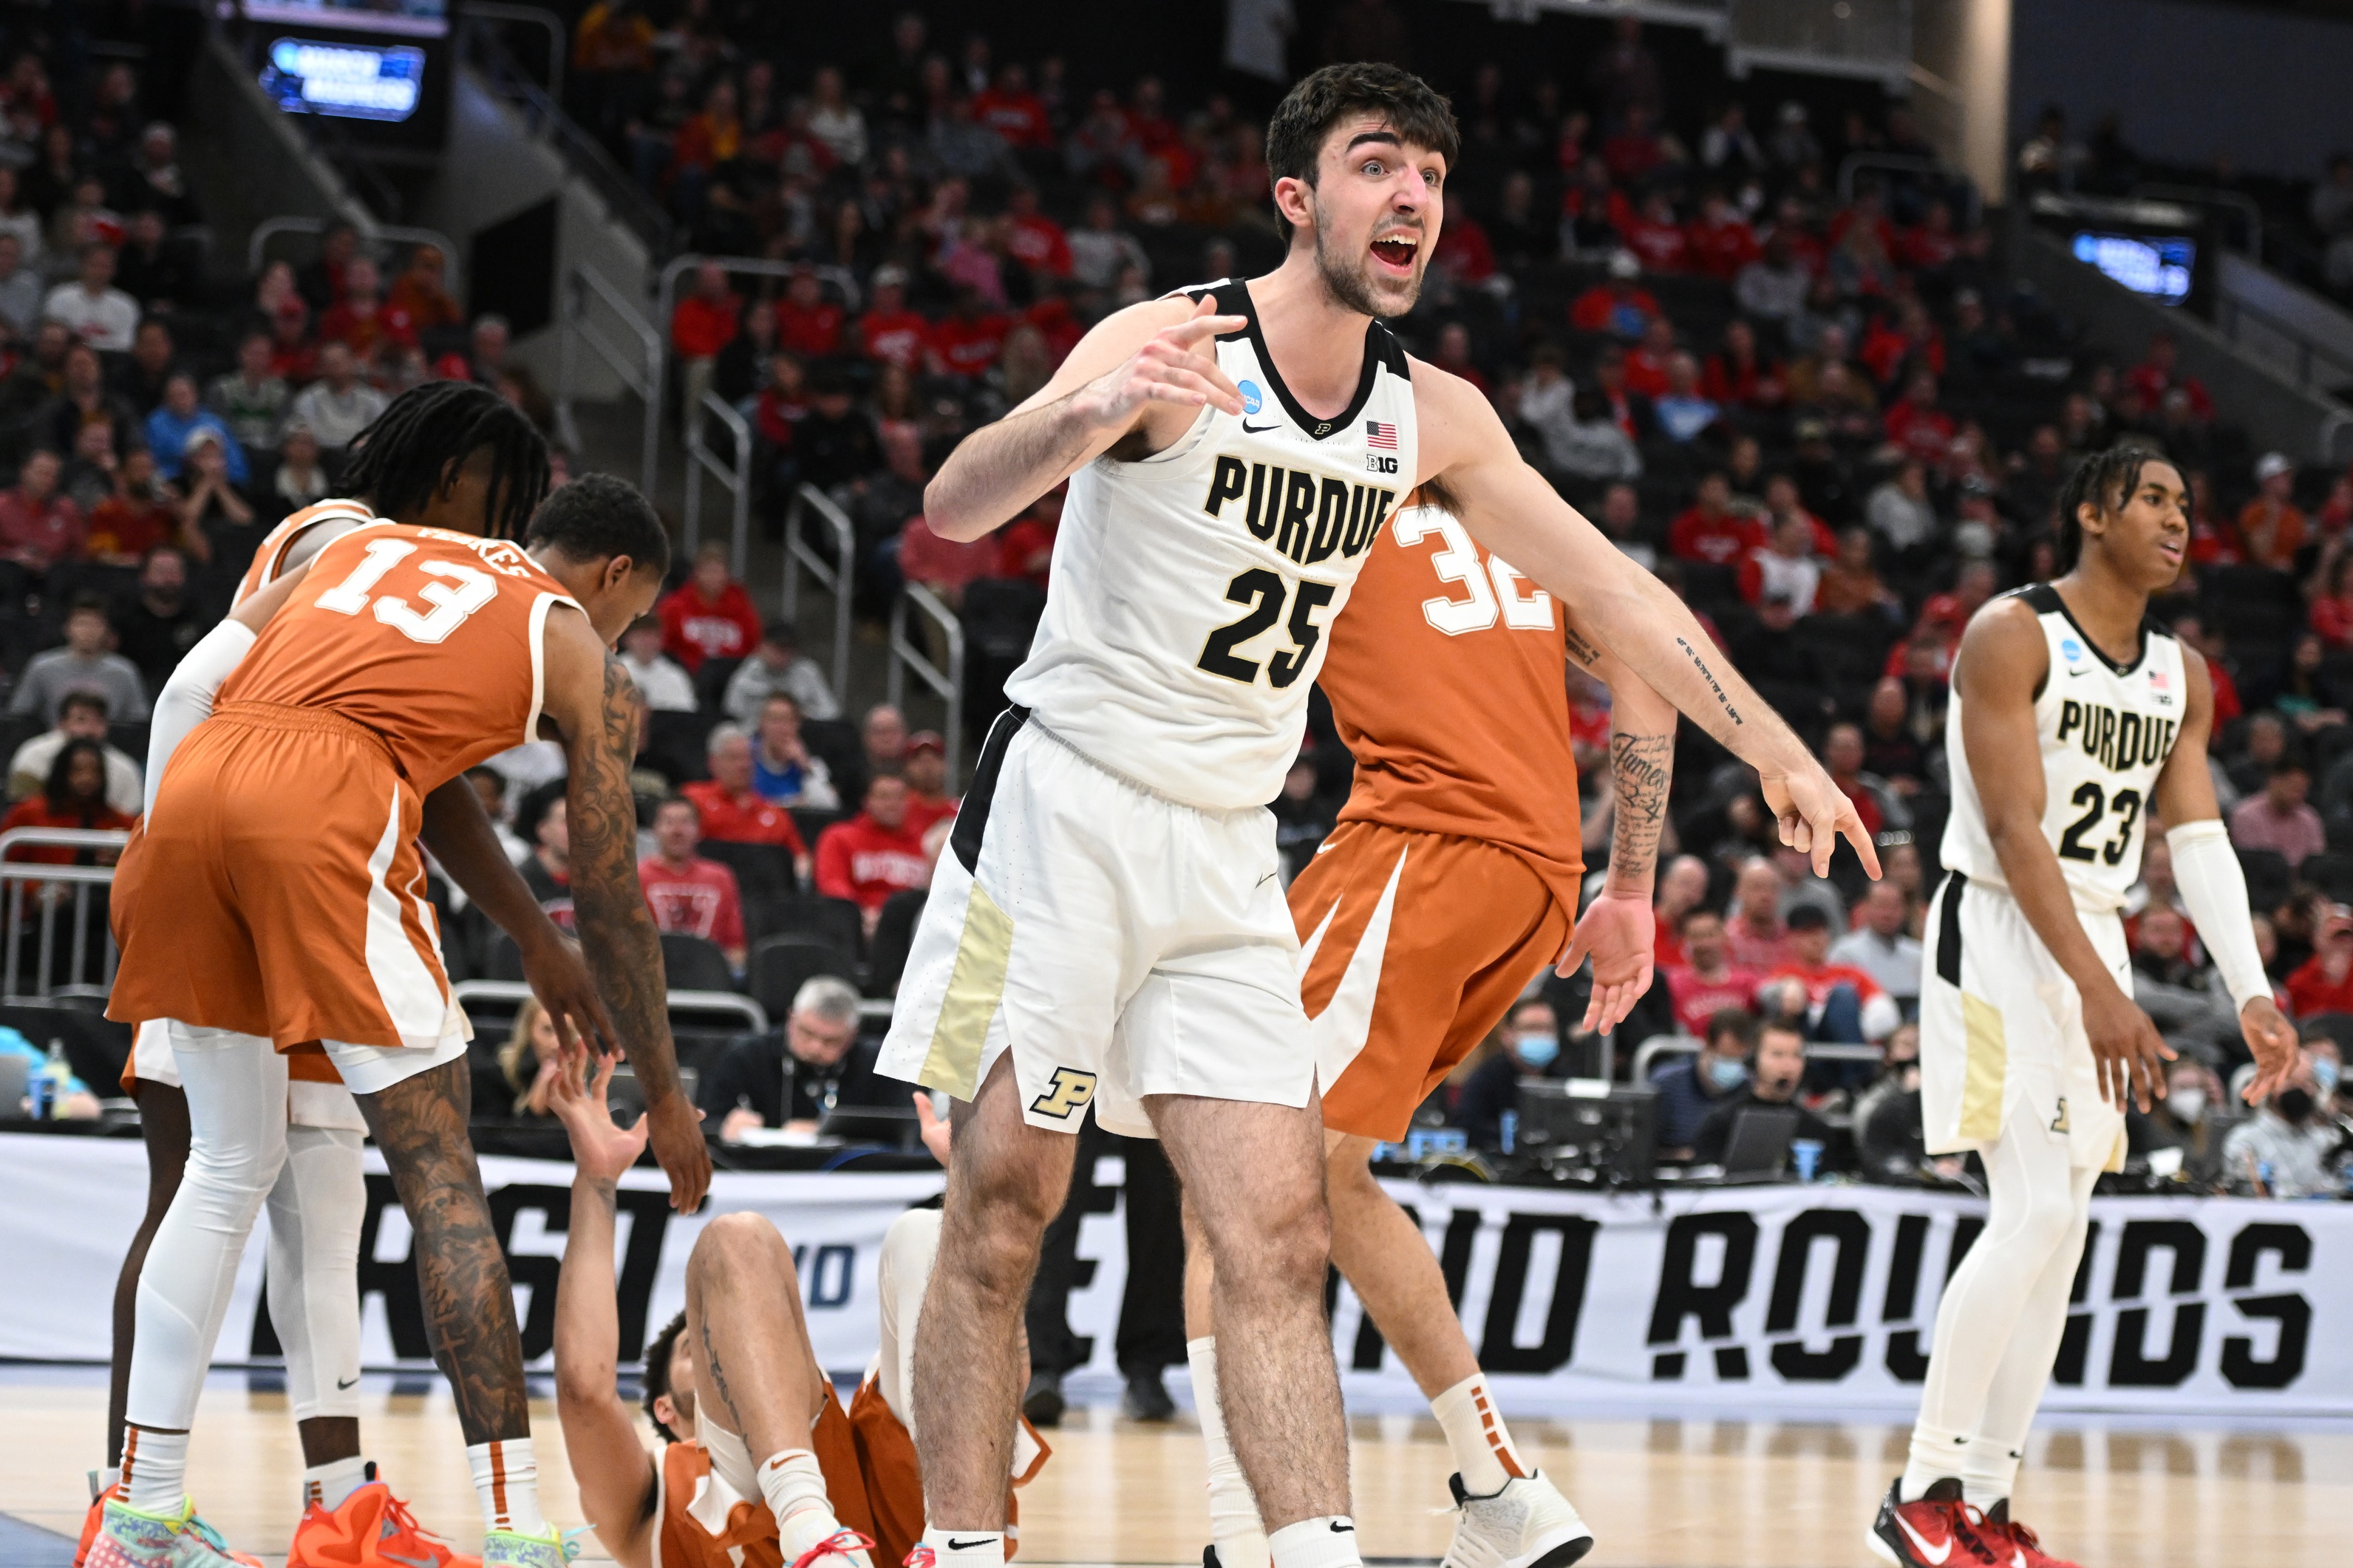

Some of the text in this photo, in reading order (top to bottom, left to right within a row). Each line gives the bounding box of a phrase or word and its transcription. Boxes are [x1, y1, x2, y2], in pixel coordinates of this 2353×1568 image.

[1315, 423, 1332, 434] P
[1202, 454, 1397, 567] PURDUE
[314, 538, 499, 644] 13
[1195, 567, 1338, 690] 25
[2057, 698, 2176, 773] PURDUE
[2059, 780, 2142, 867] 23
[1029, 1066, 1097, 1119] P
